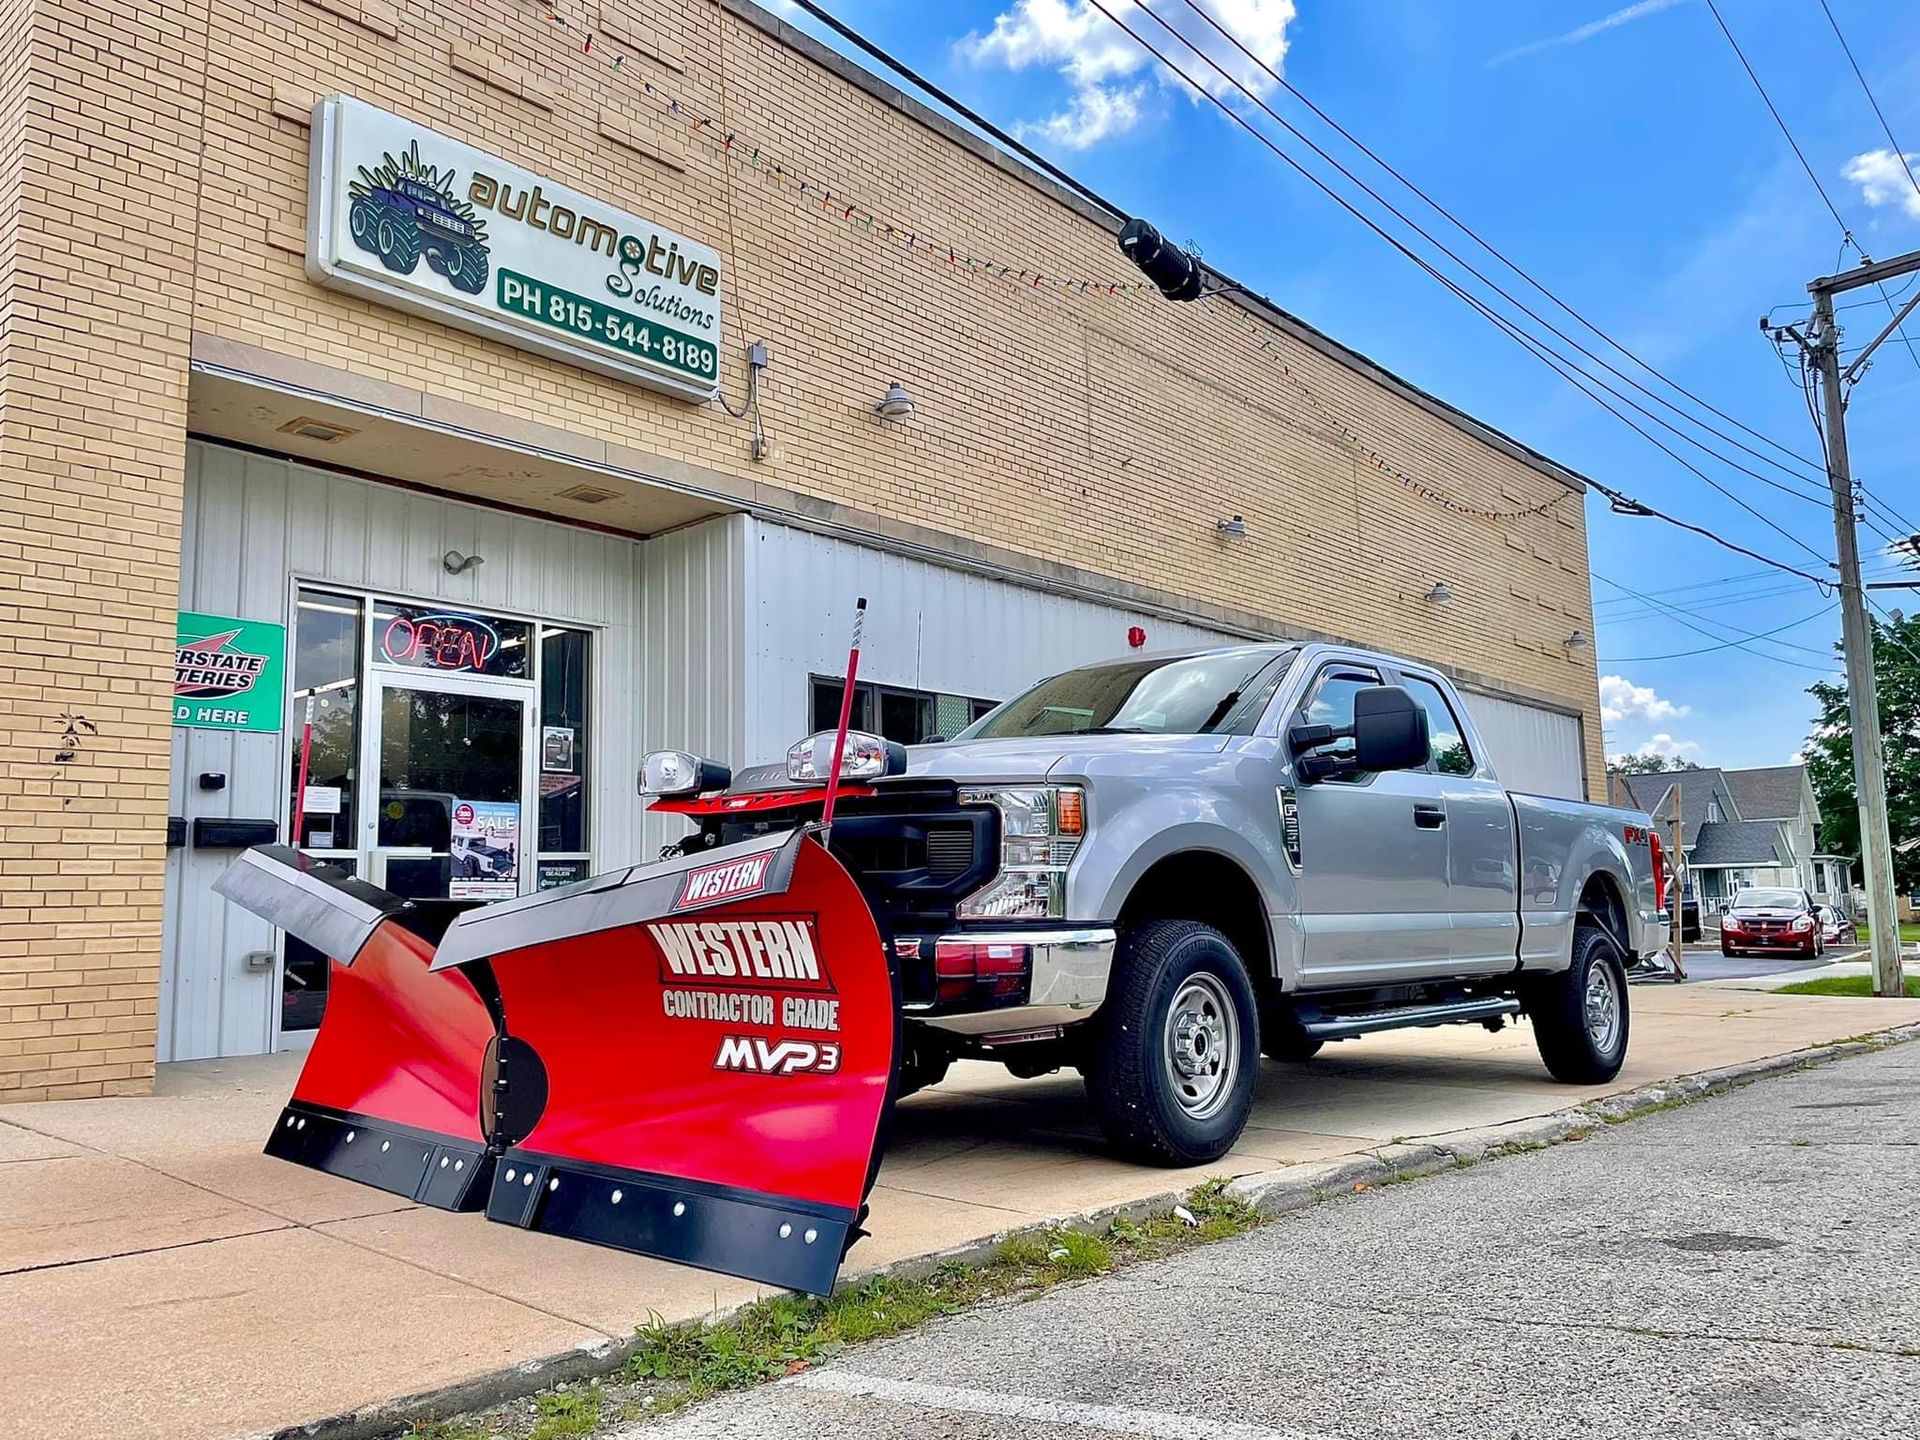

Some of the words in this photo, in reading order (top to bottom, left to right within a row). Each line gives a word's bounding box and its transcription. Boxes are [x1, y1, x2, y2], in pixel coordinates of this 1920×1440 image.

[605, 262, 714, 330] Solutions
[503, 279, 542, 316] PH
[549, 299, 714, 373] 815-544-8189
[384, 617, 489, 669] OPEN
[197, 708, 249, 724] HERE
[477, 816, 515, 830] SALE
[686, 857, 766, 901] WESTERN
[647, 920, 820, 980] WESTERN
[662, 989, 774, 1025] CONTRACTOR
[782, 997, 840, 1031] GRADE
